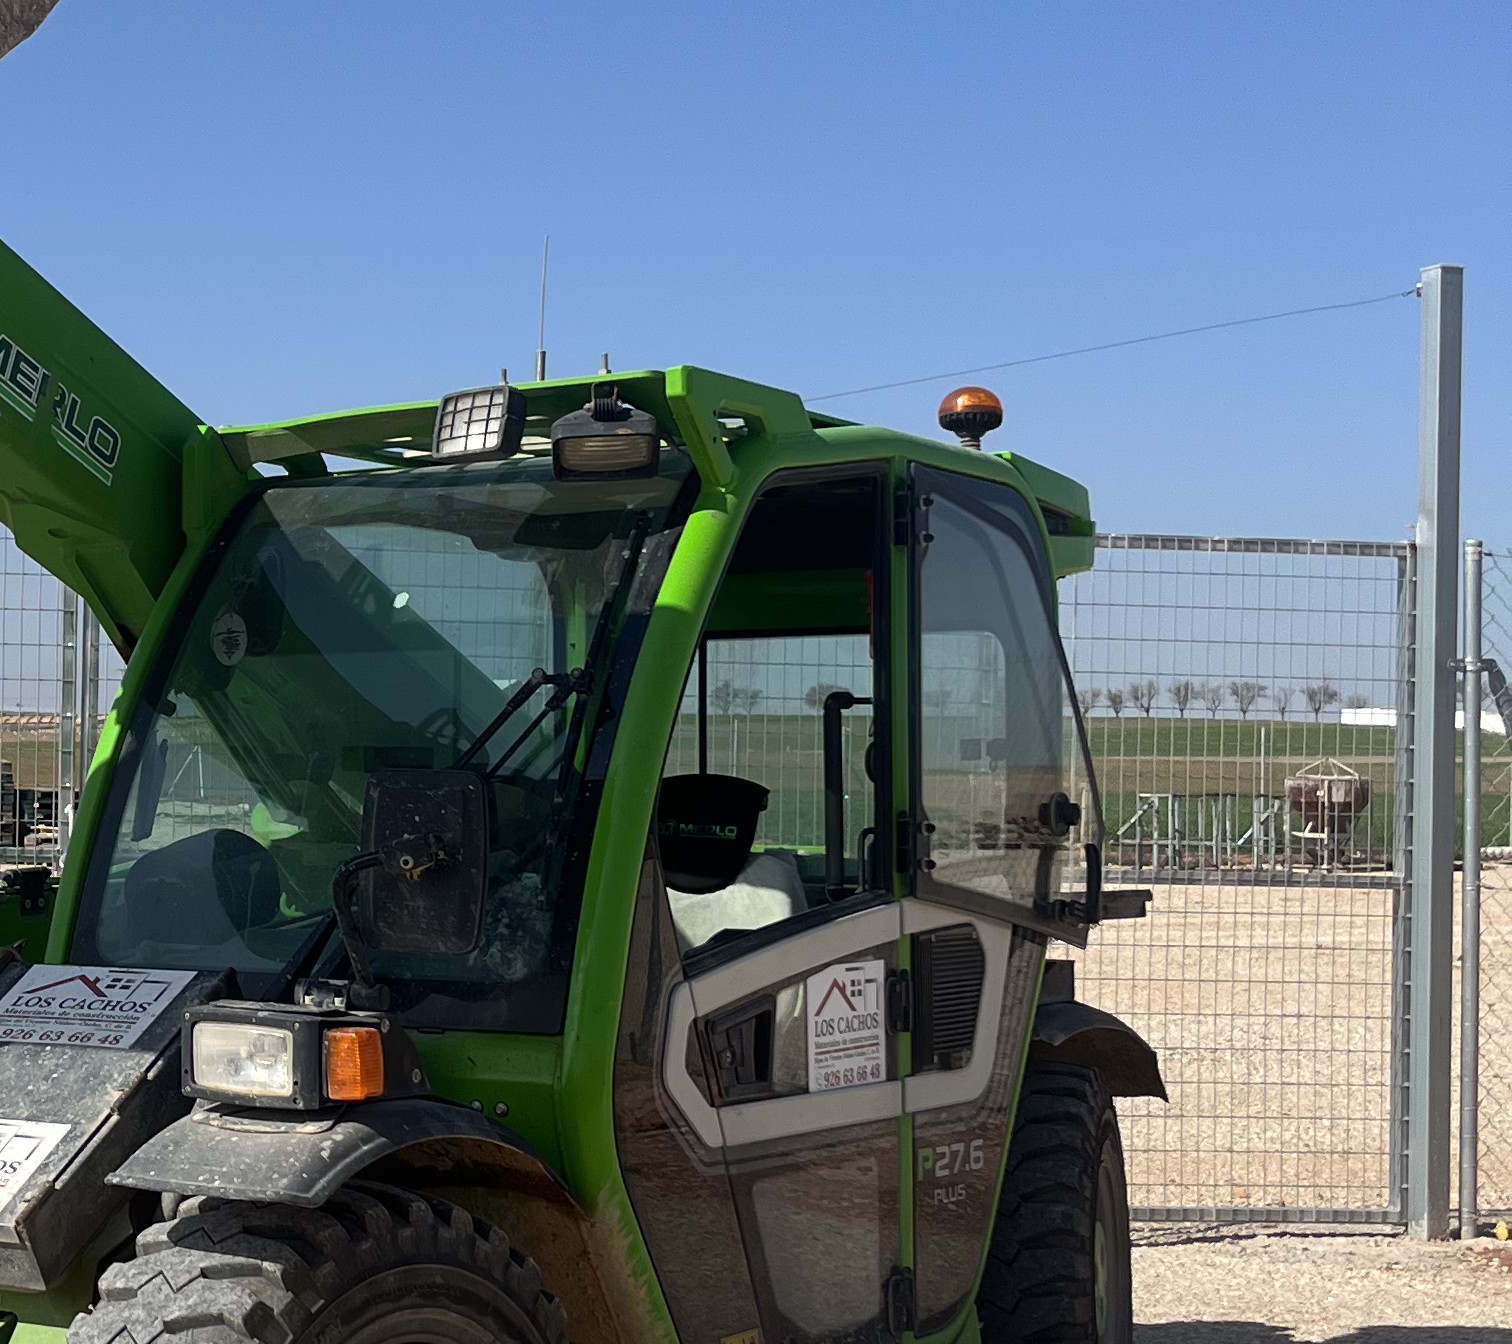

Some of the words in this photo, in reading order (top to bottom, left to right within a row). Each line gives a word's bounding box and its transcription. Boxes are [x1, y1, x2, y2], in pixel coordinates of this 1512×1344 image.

[10, 996, 57, 1007] LOS
[57, 998, 153, 1012] CACHOS
[72, 1011, 143, 1020] construcción
[815, 1018, 834, 1037] LOS
[837, 1012, 879, 1034] CACHOS
[0, 1028, 37, 1039] 926
[38, 1030, 66, 1040] 63
[67, 1032, 96, 1042] 66
[96, 1034, 125, 1044] 48
[824, 1070, 840, 1088] 926
[843, 1067, 854, 1084] 63
[856, 1065, 867, 1082] 66
[870, 1063, 880, 1079] 48
[918, 1139, 984, 1181] P27.6
[934, 1184, 967, 1205] PLUS
